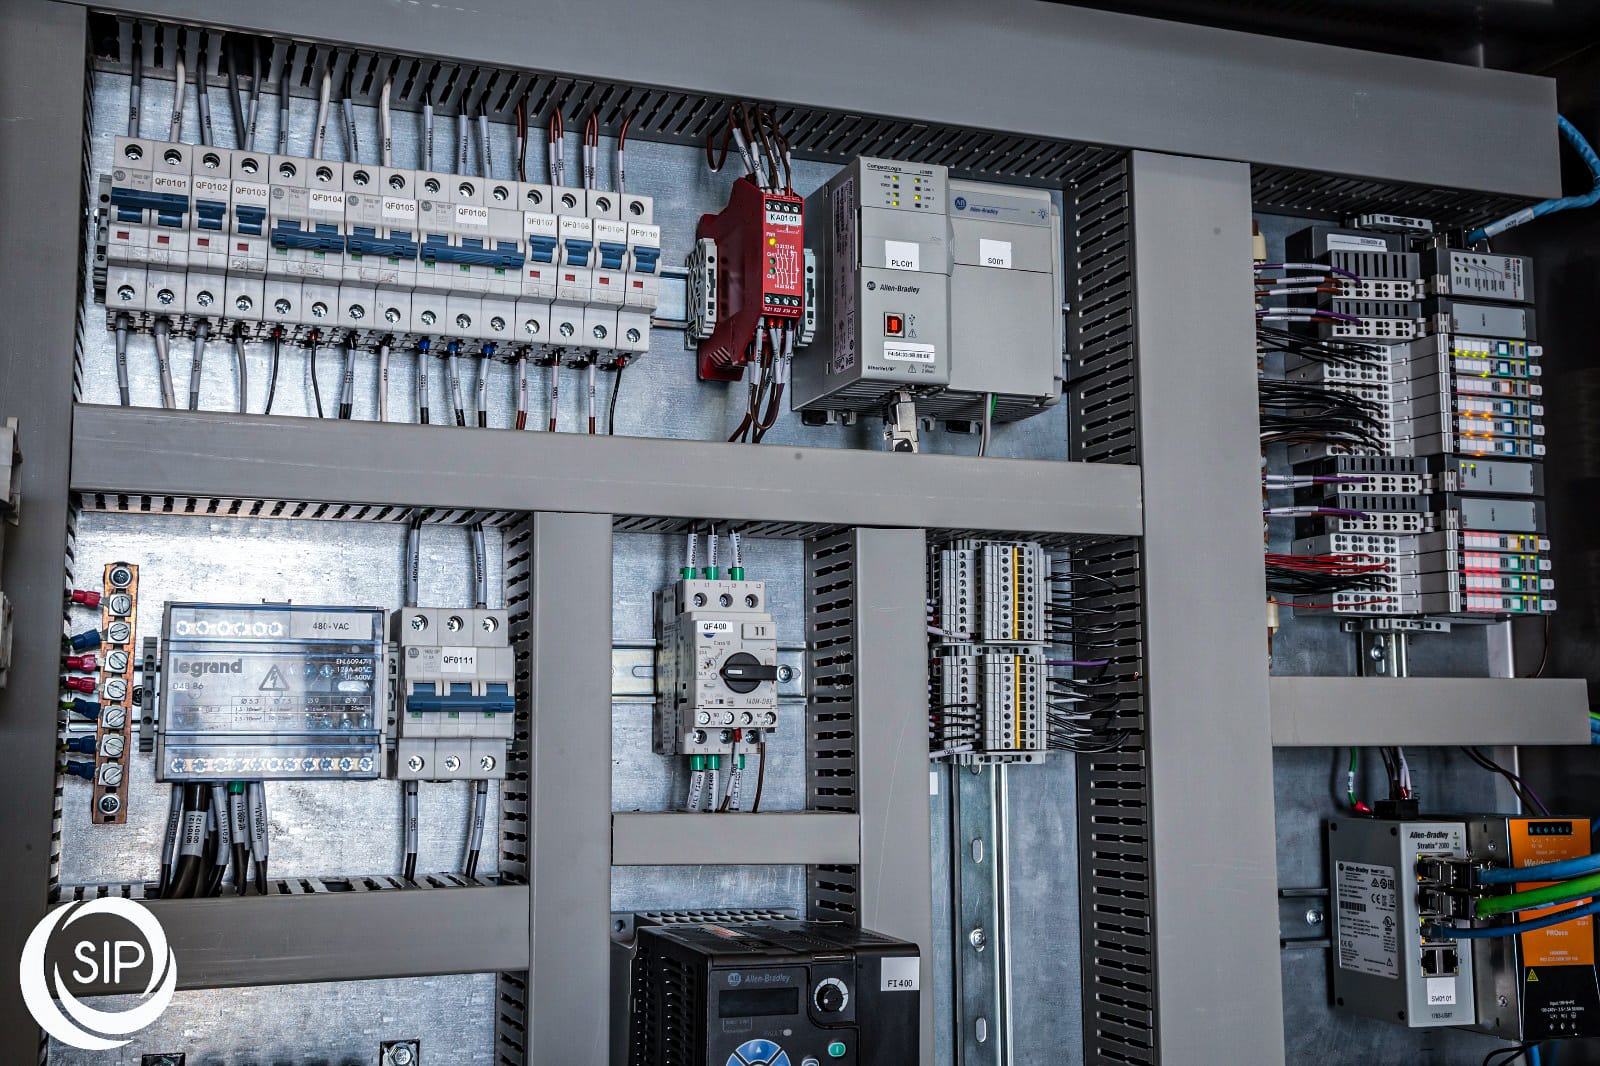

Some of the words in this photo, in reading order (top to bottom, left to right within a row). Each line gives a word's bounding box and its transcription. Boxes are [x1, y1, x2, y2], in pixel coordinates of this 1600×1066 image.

[155, 177, 187, 188] QF0101
[195, 181, 228, 192] QF0102
[235, 186, 267, 197] QF0103
[312, 193, 343, 204] QF0104
[385, 202, 415, 212] QF0105
[458, 208, 487, 218] QF0106
[891, 260, 913, 268] PLC01
[880, 284, 920, 294] Allen-Bradley
[443, 656, 473, 664] QF0111
[173, 658, 242, 677] legrand
[1410, 832, 1448, 840] Allen-Bradley
[887, 979, 912, 988] FI400
